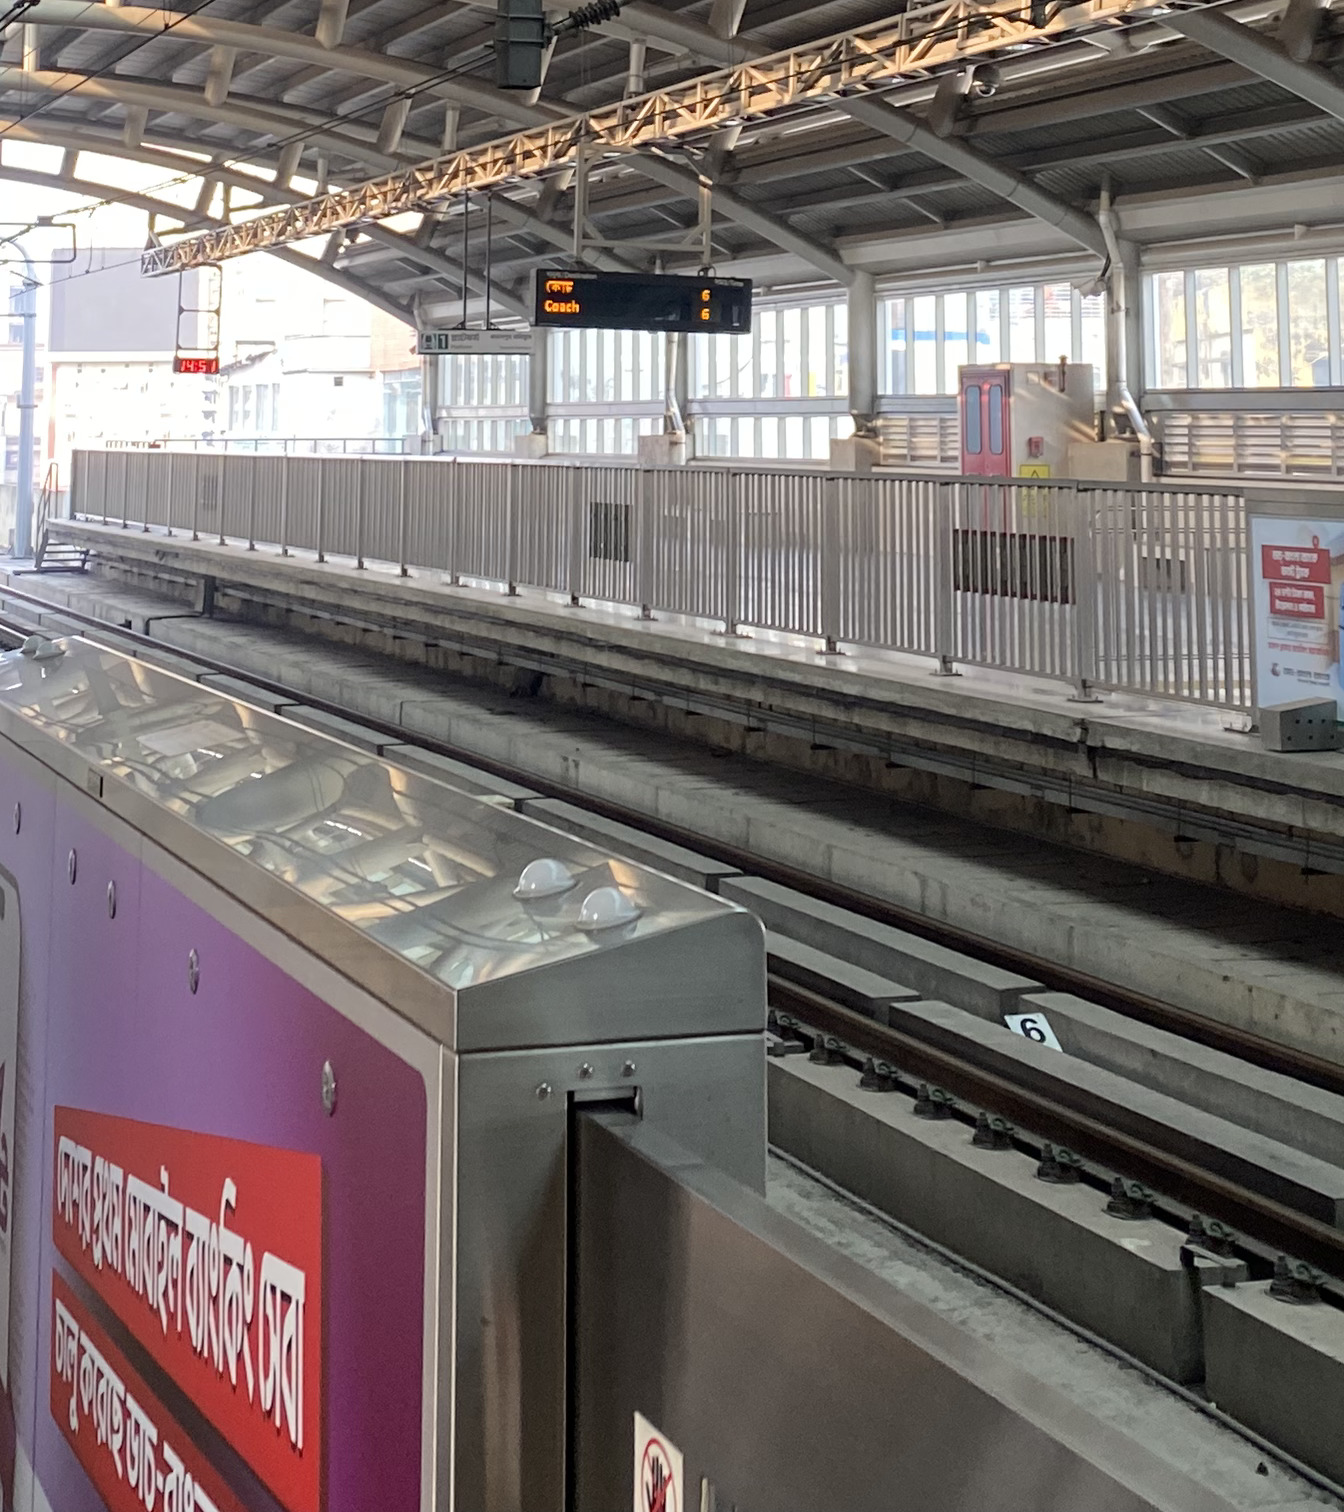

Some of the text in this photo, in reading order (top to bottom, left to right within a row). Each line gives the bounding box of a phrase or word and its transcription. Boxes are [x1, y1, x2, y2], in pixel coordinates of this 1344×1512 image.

[701, 289, 711, 302] 6
[544, 299, 710, 321] Coach 6
[181, 359, 216, 373] 14:51
[1020, 1018, 1046, 1043] 6
[57, 1136, 306, 1452] দেশের প্রথম মোবাইল ব্যাংকিং সেবা
[56, 1298, 79, 1435] চালু
[80, 1330, 126, 1480] করেছে
